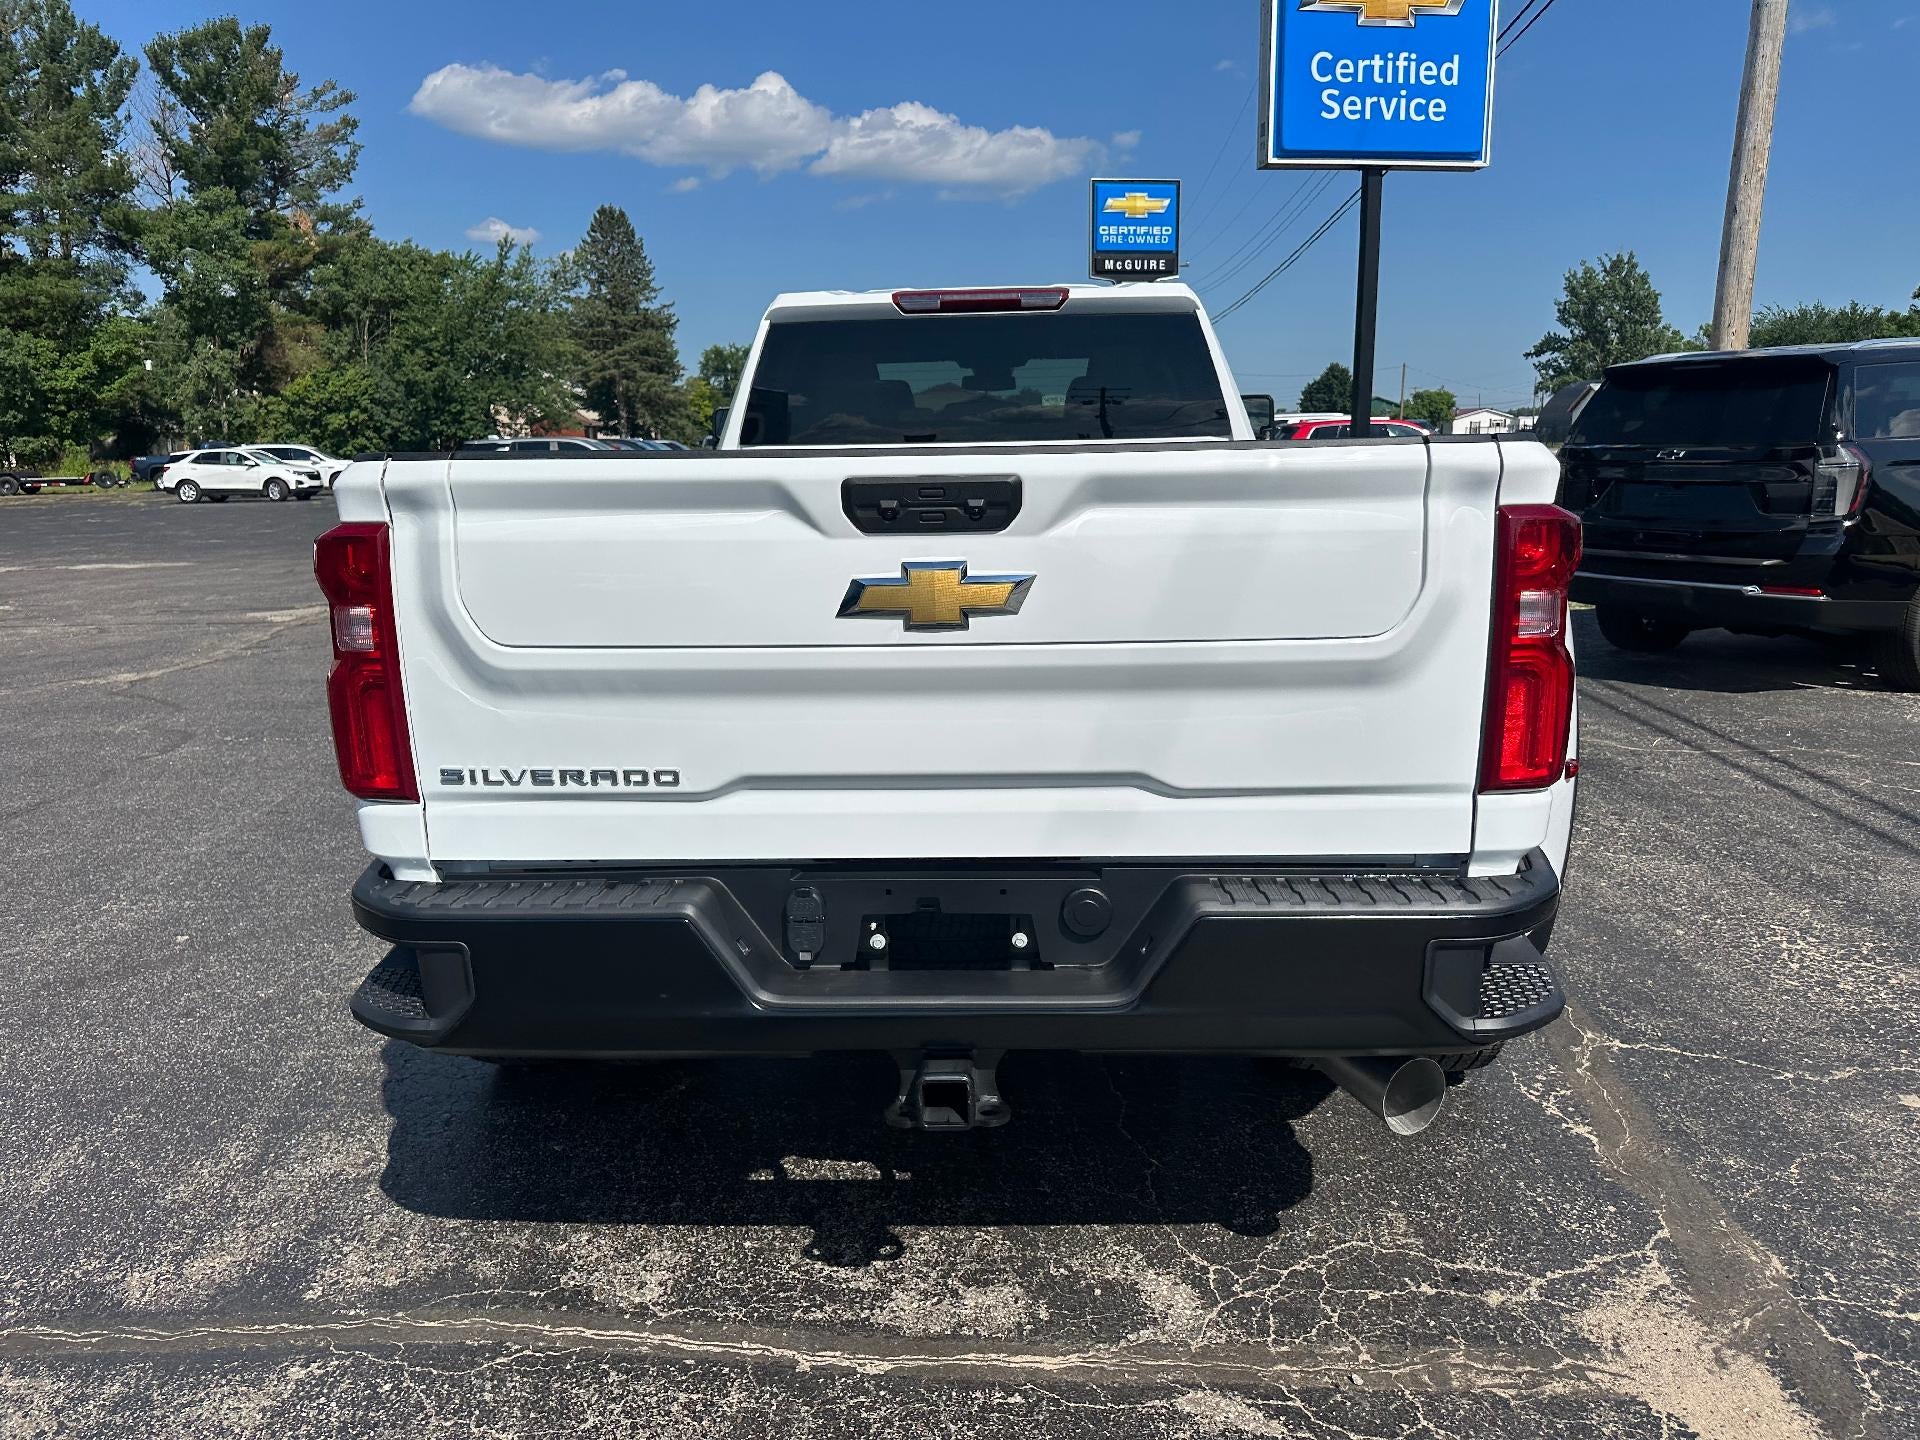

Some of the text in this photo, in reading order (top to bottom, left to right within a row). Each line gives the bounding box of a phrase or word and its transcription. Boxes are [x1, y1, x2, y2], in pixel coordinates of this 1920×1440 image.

[1310, 51, 1460, 87] Certified
[1320, 89, 1447, 122] Service
[1099, 225, 1172, 235] CERTIFIED
[1102, 235, 1169, 244] PRE-OWNED
[1104, 259, 1166, 270] McGUIRE
[440, 768, 680, 787] SILVERADO
